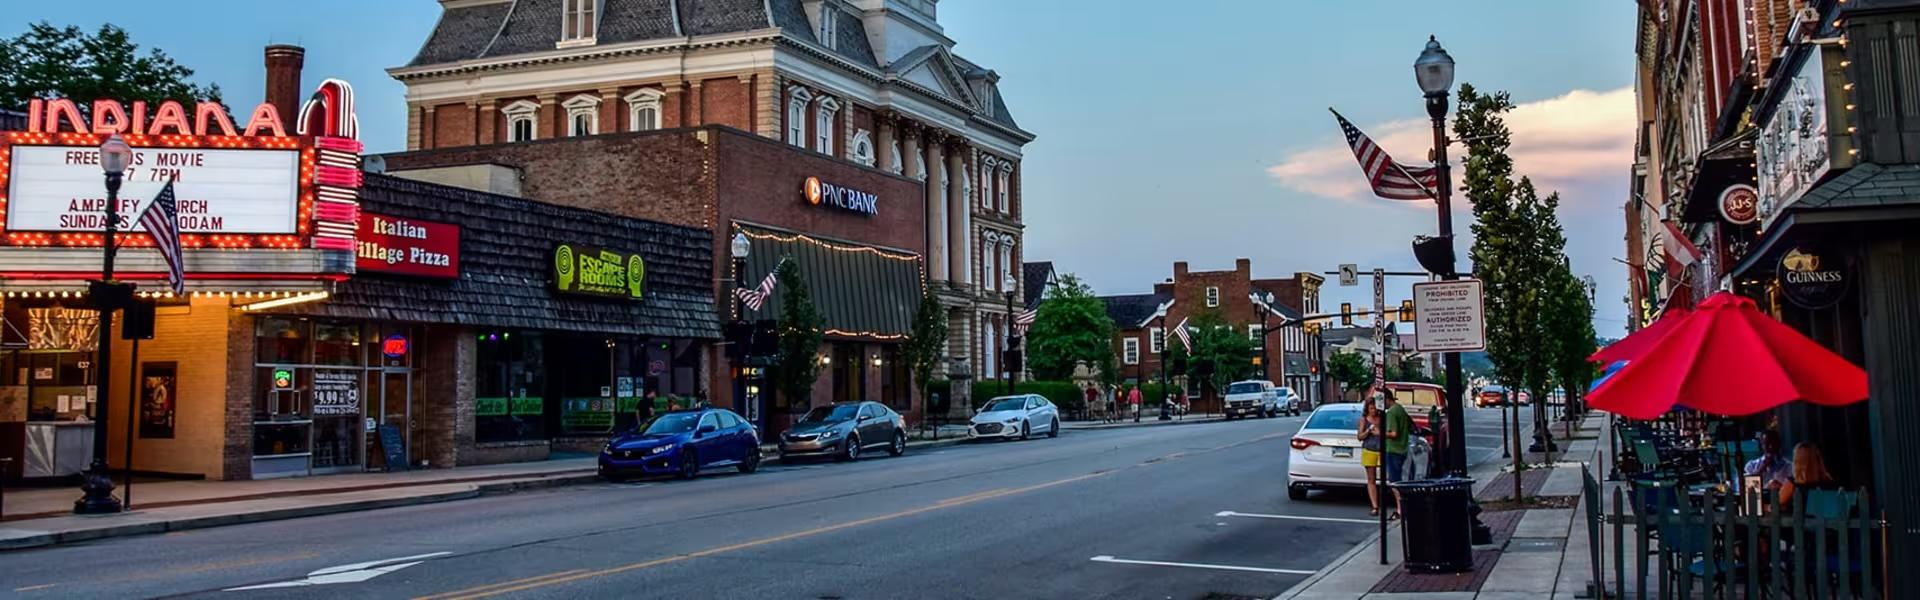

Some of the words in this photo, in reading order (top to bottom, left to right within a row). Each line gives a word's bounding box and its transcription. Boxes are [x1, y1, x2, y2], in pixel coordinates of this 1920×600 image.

[28, 98, 287, 137] INDIANA
[65, 151, 99, 165] FREE
[156, 152, 204, 167] MOVIE
[150, 168, 181, 182] 7PM
[68, 198, 141, 212] AMPIFY
[822, 182, 846, 208] PNC
[847, 188, 878, 215] BANK
[373, 217, 427, 240] Italian
[357, 241, 404, 265] illage
[409, 246, 450, 267] Pizza
[580, 254, 625, 276] ESCAPE
[580, 271, 625, 288] ROOMS
[1786, 270, 1842, 284] GUINNESS
[1425, 289, 1469, 298] PROHIBITED
[1426, 315, 1472, 325] AUTHORIZED
